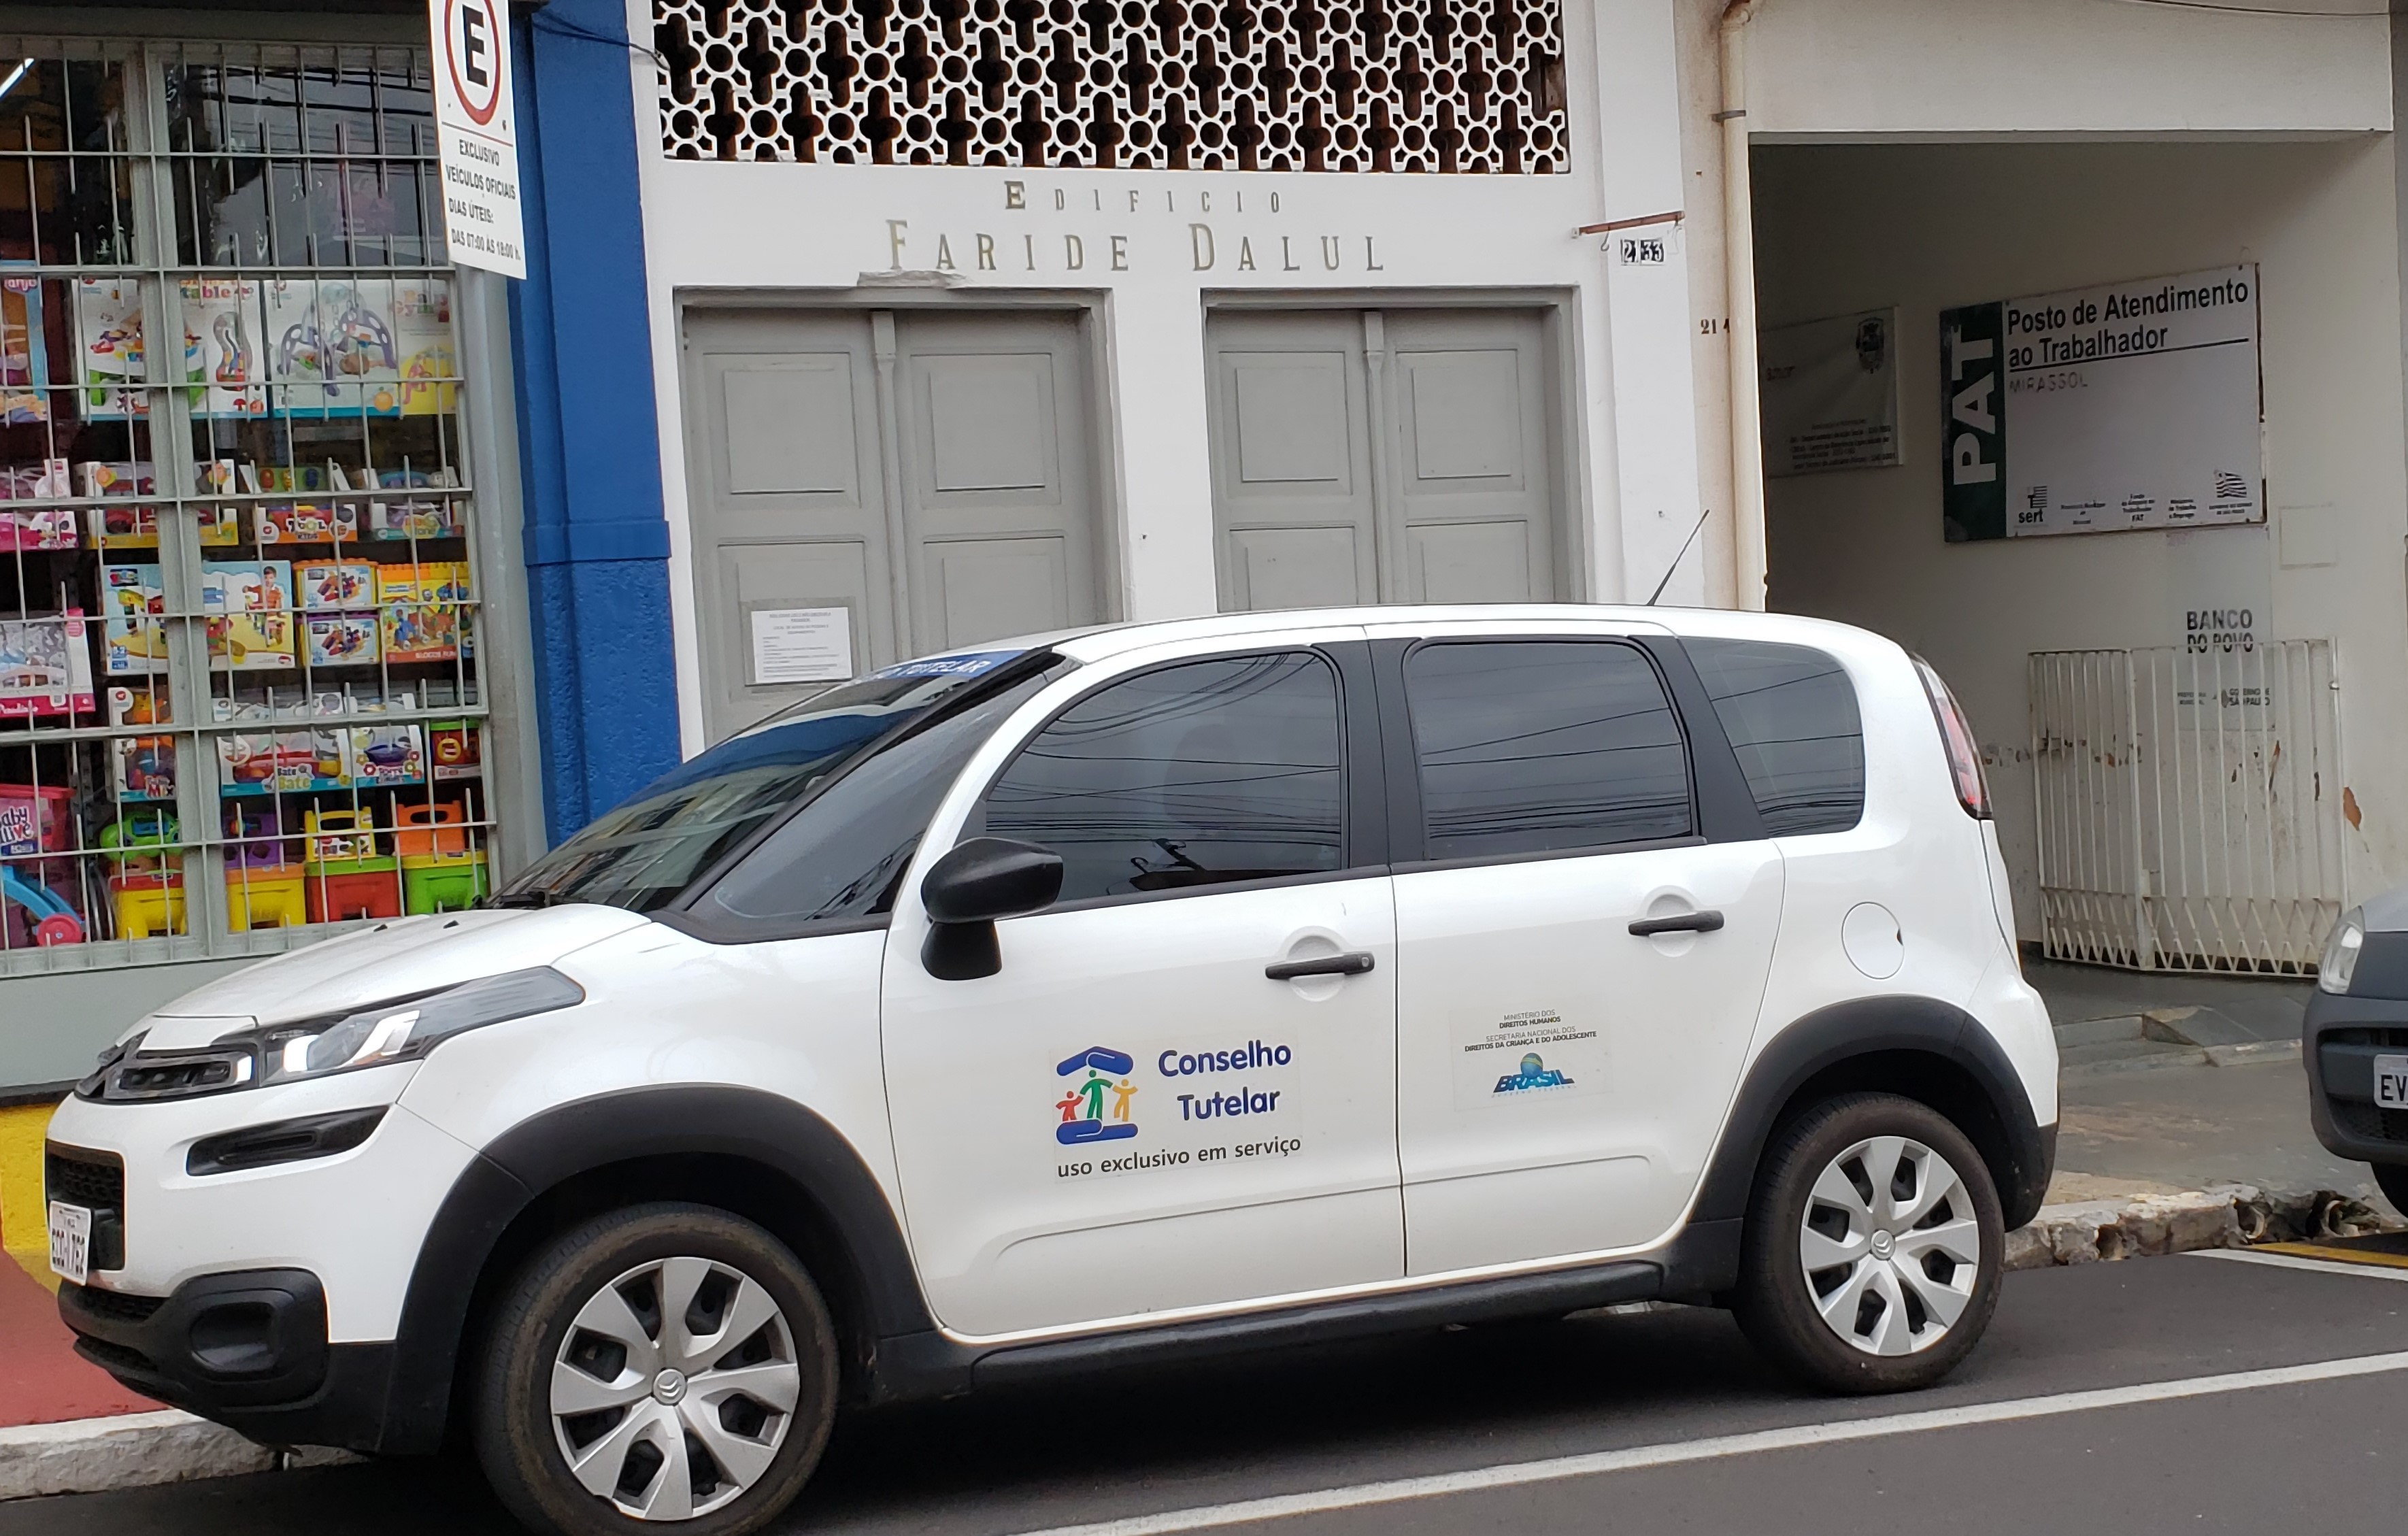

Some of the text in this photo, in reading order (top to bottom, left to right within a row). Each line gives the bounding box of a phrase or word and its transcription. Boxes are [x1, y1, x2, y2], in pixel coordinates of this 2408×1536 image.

[463, 4, 488, 88] E
[459, 139, 500, 166] EXCLUSIVO
[446, 164, 516, 200] VEÍCULOS OFICIAIS
[448, 197, 467, 216] DIAS
[452, 229, 465, 246] DAS
[467, 233, 484, 251] 07:00
[886, 219, 1384, 271] FARIDE DALUL
[2008, 278, 2248, 335] Posto de Atendimento
[2009, 324, 2168, 367] ao Trabalhador
[1951, 324, 1996, 485] PAT
[2018, 509, 2043, 523] sert
[2187, 609, 2253, 631] BANCO
[0, 807, 28, 827] aby
[0, 822, 33, 844] live
[1486, 1031, 1526, 1042] SECRETARIA
[1527, 1027, 1560, 1037] NACIONAL
[1499, 1016, 1561, 1029] DIREITOS HUMANOS
[1465, 1042, 1494, 1052] DIREITOS
[1506, 1037, 1534, 1046] CRIANÇA
[1552, 1031, 1597, 1042] ADOLESCENTE
[1158, 1039, 1292, 1078] Conselho
[1493, 1069, 1575, 1093] BRASIL
[1177, 1086, 1280, 1121] Tutelar
[1058, 1135, 1302, 1178] uso exclusivo em serviço
